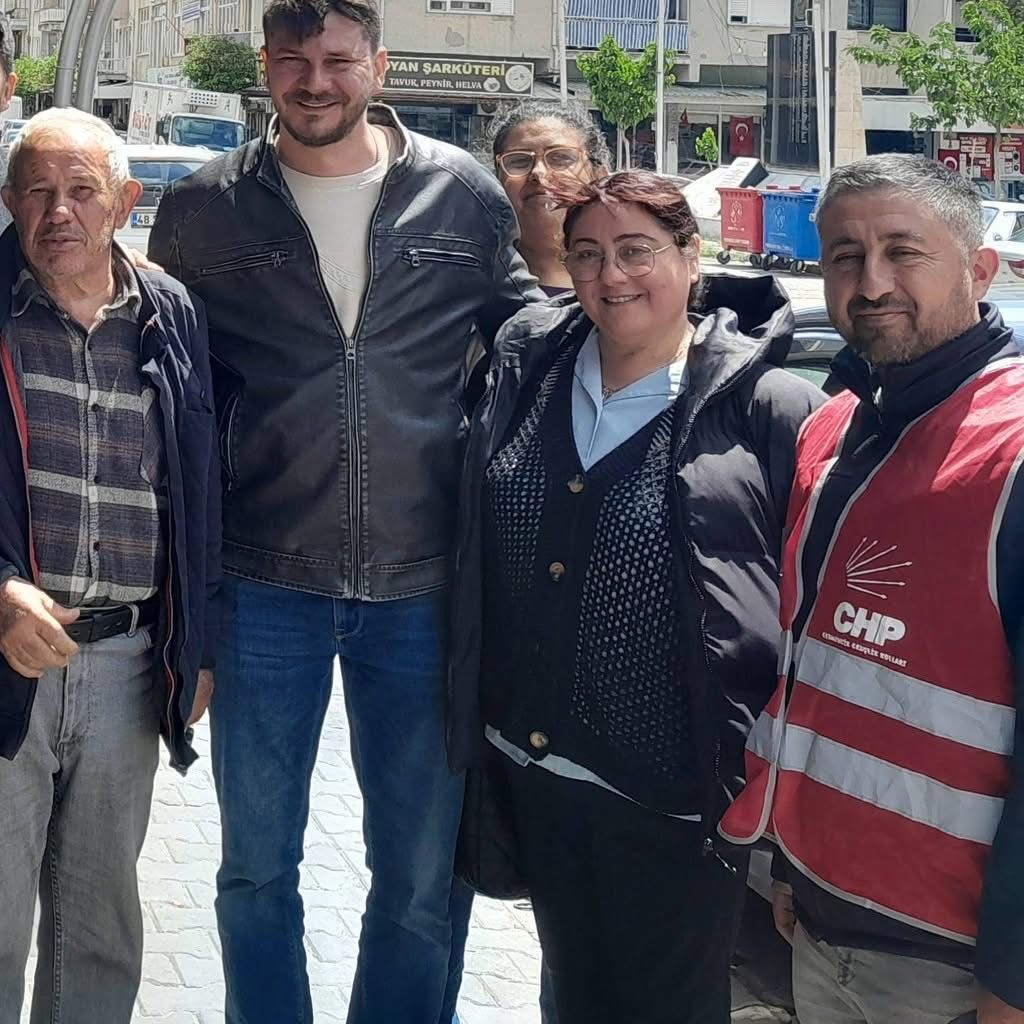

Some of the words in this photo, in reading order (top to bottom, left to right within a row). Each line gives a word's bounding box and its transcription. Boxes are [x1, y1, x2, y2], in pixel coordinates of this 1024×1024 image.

[423, 62, 505, 76] ŞARKÜTERİ
[455, 80, 482, 89] HELVA
[137, 214, 150, 224] 48
[834, 601, 906, 646] CHP
